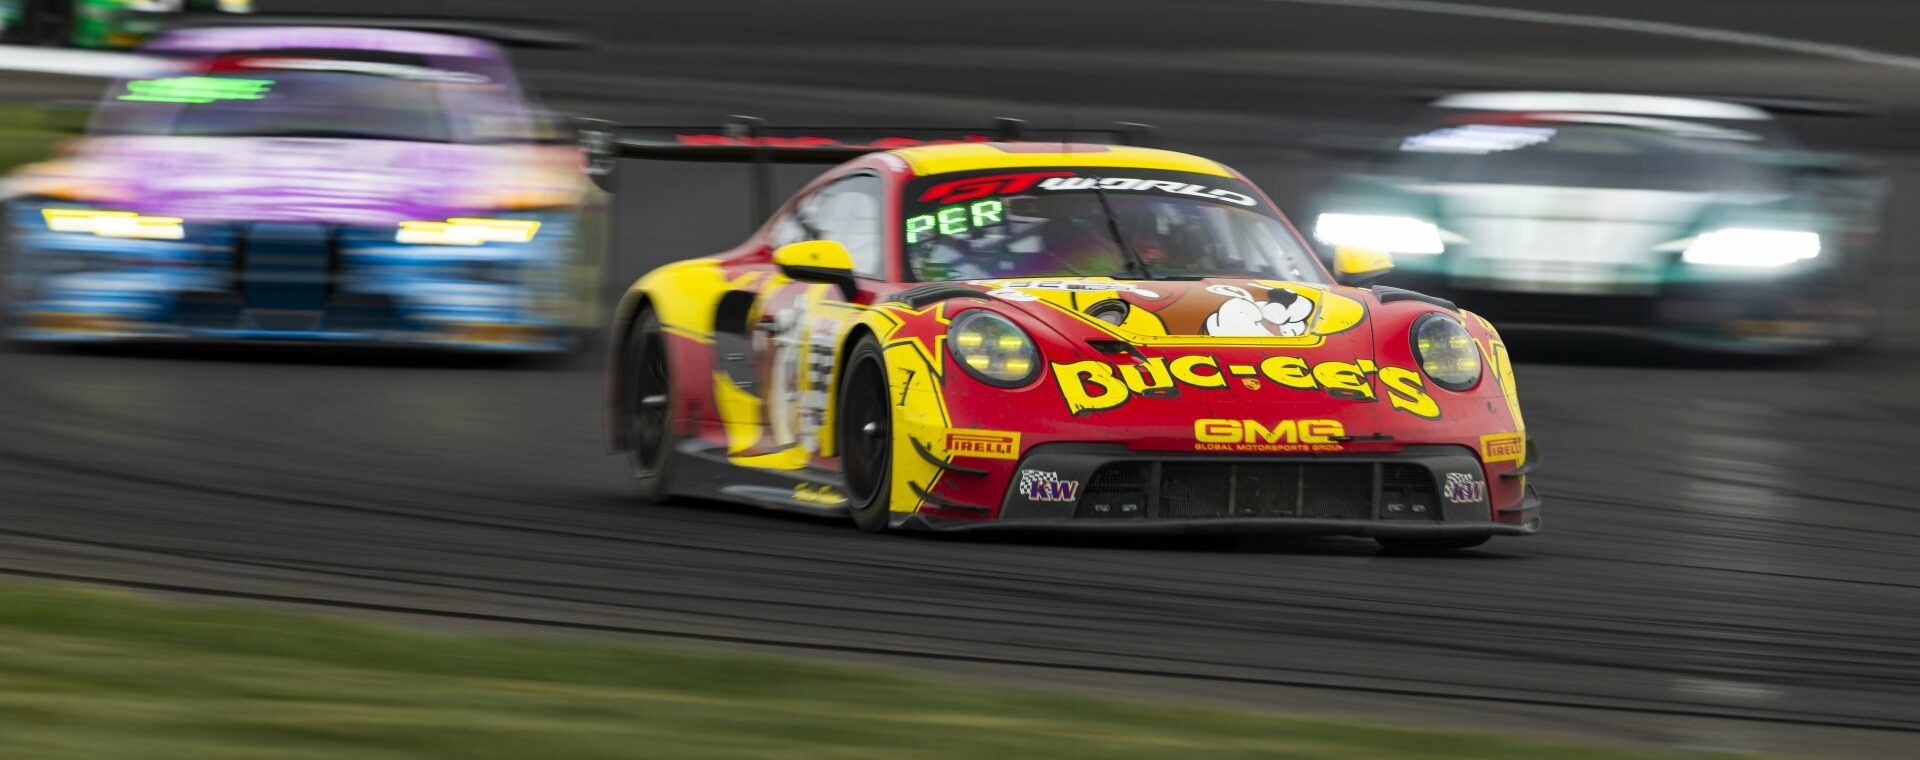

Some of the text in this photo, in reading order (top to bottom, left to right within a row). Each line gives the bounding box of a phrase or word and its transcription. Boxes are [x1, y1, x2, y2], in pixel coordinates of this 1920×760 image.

[906, 200, 1003, 244] PER
[1194, 418, 1345, 444] GMG
[945, 433, 1014, 454] PIRELLI
[1194, 443, 1232, 451] GLOBAL
[1236, 443, 1310, 452] MOTORSPORTS
[1029, 478, 1079, 501] KW
